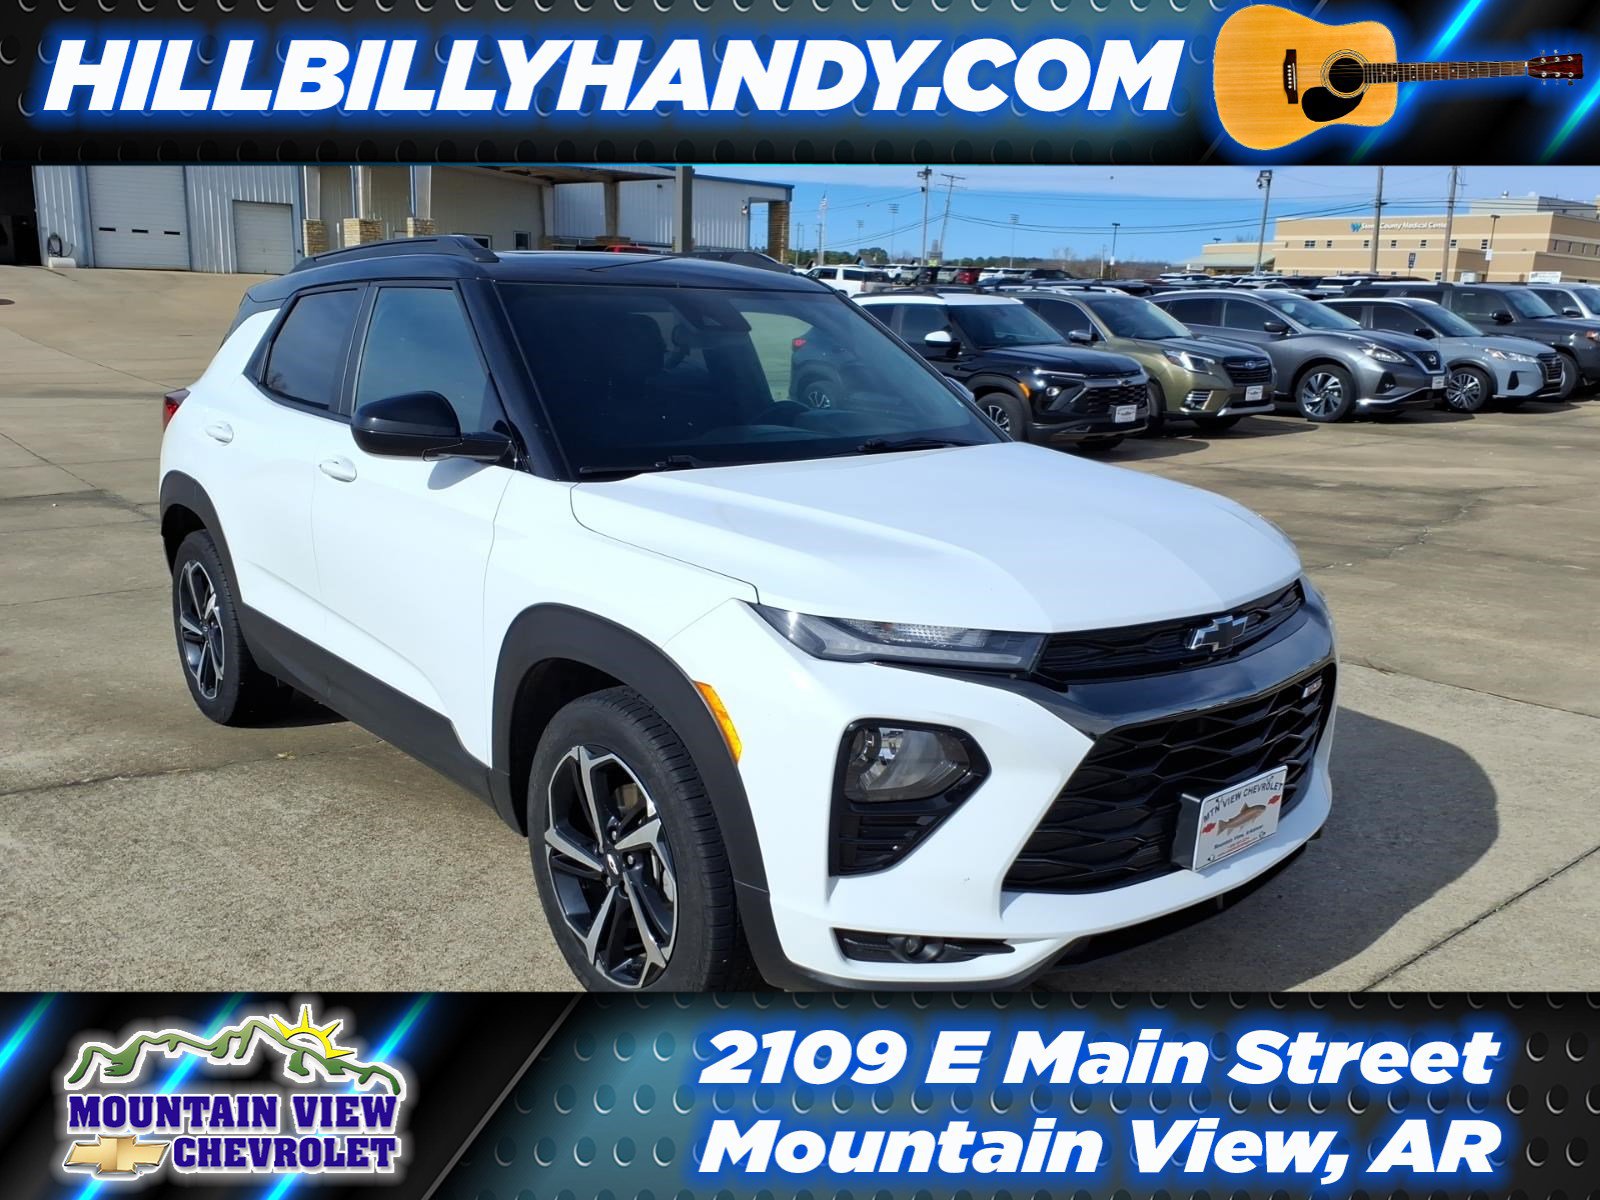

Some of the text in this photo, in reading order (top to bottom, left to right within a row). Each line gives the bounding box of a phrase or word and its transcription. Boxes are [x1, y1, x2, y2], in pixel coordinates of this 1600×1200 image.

[1203, 782, 1283, 822] MTN VIEW CHEVROLET
